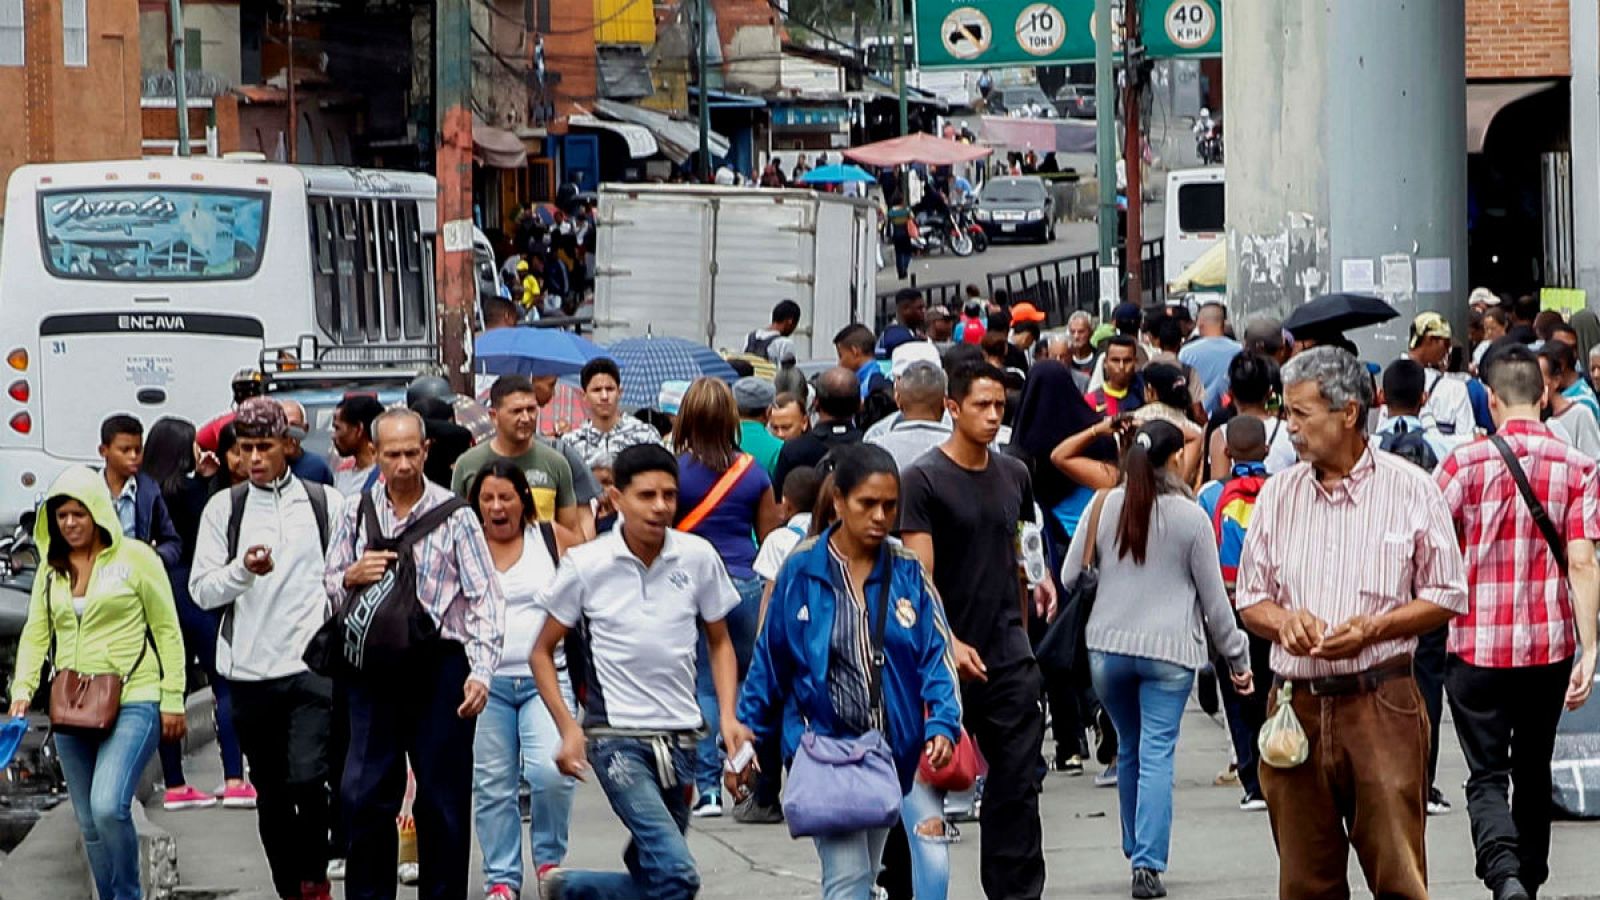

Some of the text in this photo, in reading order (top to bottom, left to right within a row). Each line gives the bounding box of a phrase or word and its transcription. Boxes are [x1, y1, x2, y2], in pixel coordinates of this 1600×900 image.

[1173, 4, 1203, 24] 40
[1031, 12, 1053, 32] 10
[1177, 28, 1202, 40] KPH
[1030, 35, 1053, 48] TONS
[118, 315, 185, 329] ENCAVA
[53, 341, 67, 354] 31
